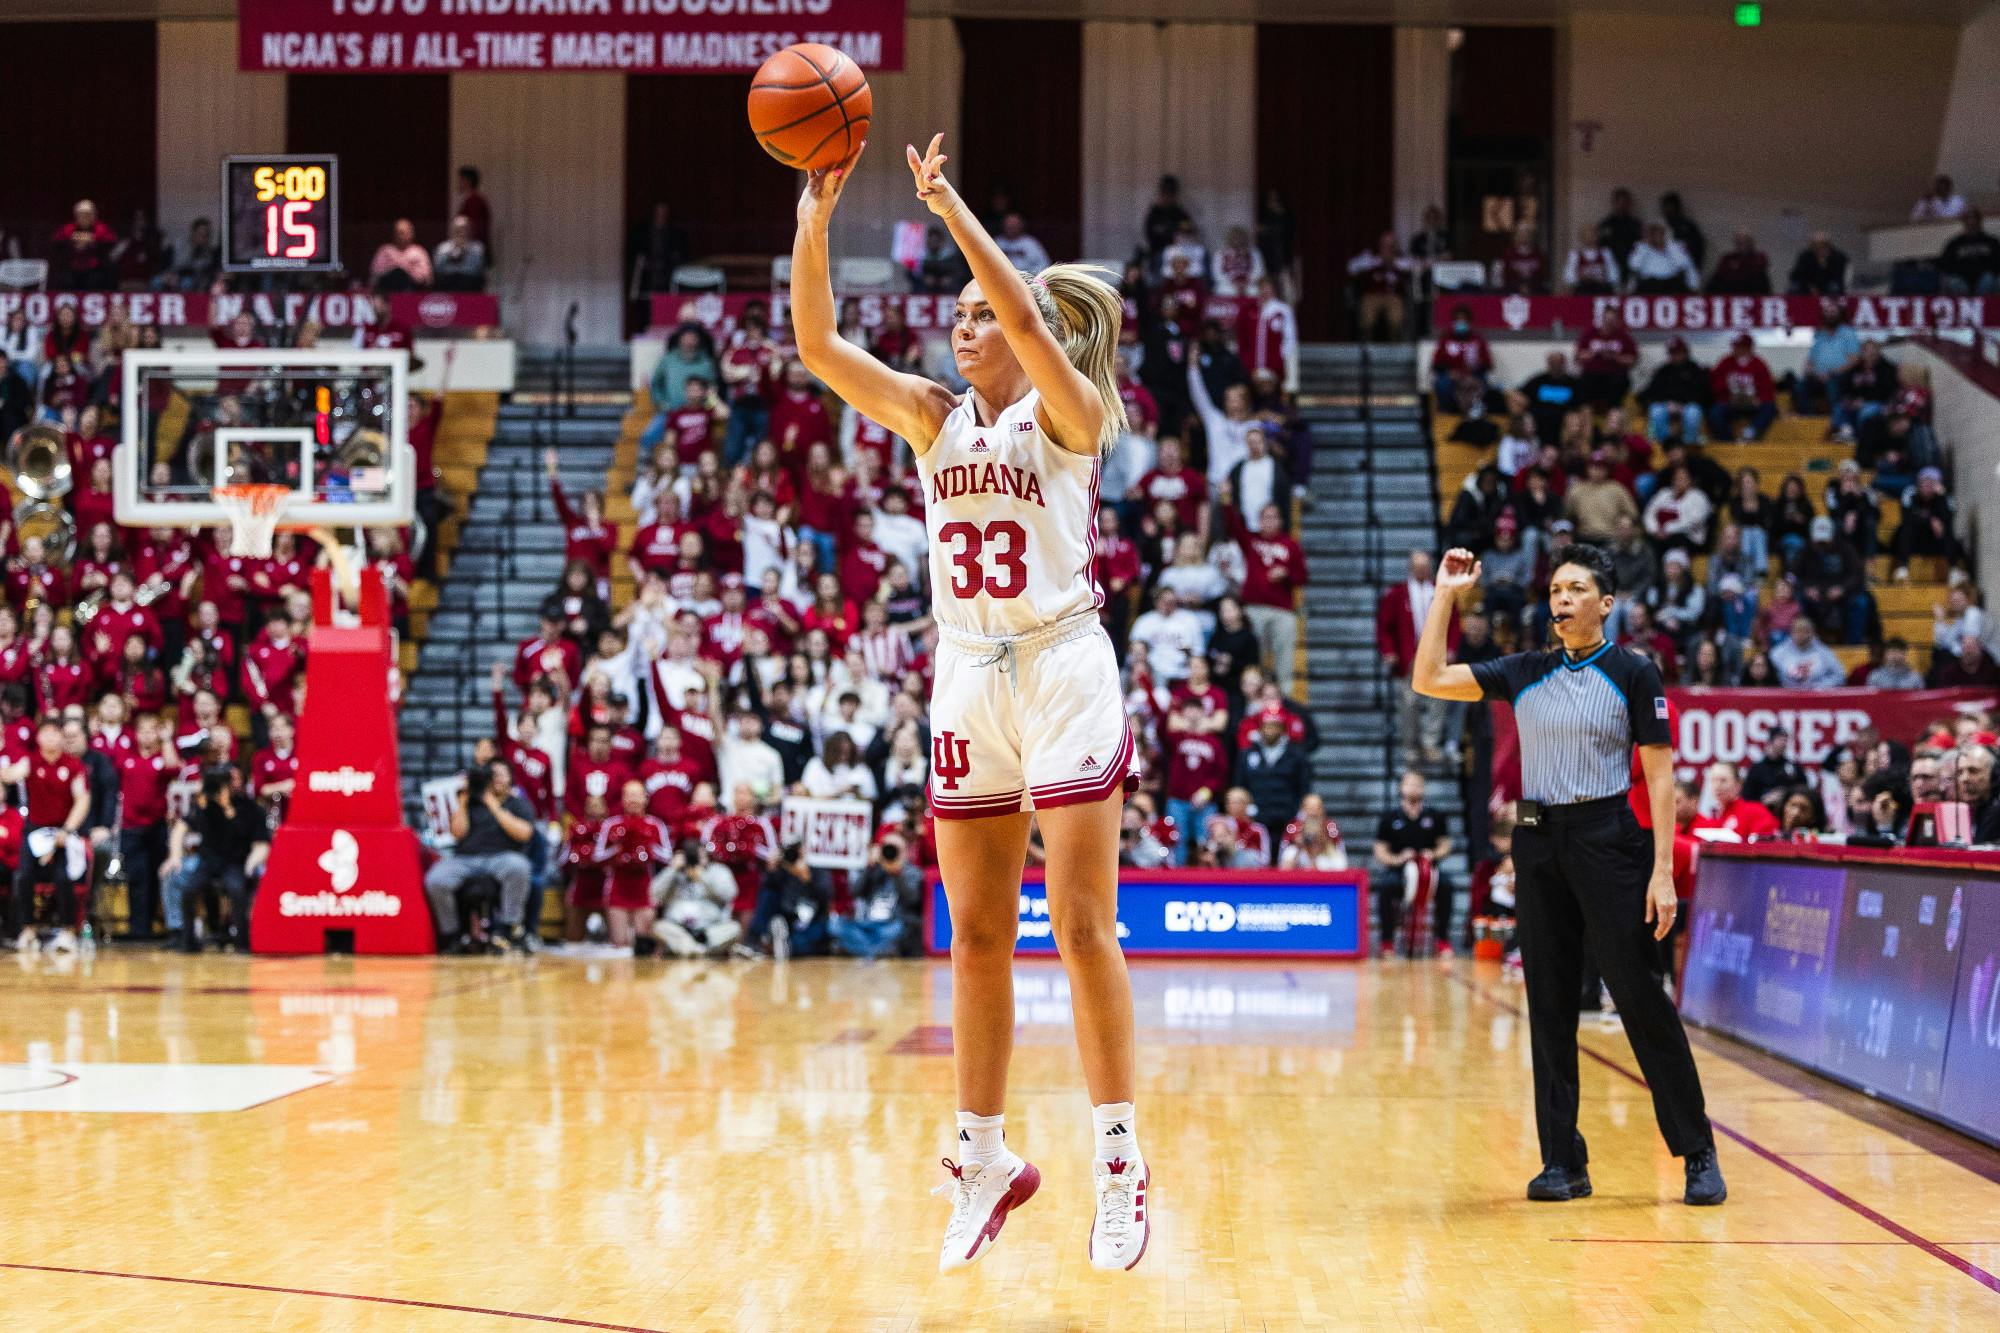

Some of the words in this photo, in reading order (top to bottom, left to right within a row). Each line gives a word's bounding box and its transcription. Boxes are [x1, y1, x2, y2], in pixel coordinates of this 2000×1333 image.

[262, 32, 363, 67] NCAA'S
[370, 32, 401, 67] #1
[412, 32, 545, 67] ALL-TIME
[552, 32, 655, 67] MARCH
[254, 166, 325, 201] 5:00
[266, 201, 316, 258] 15
[939, 521, 1027, 599] 33
[1673, 709, 1872, 764] OOSIER
